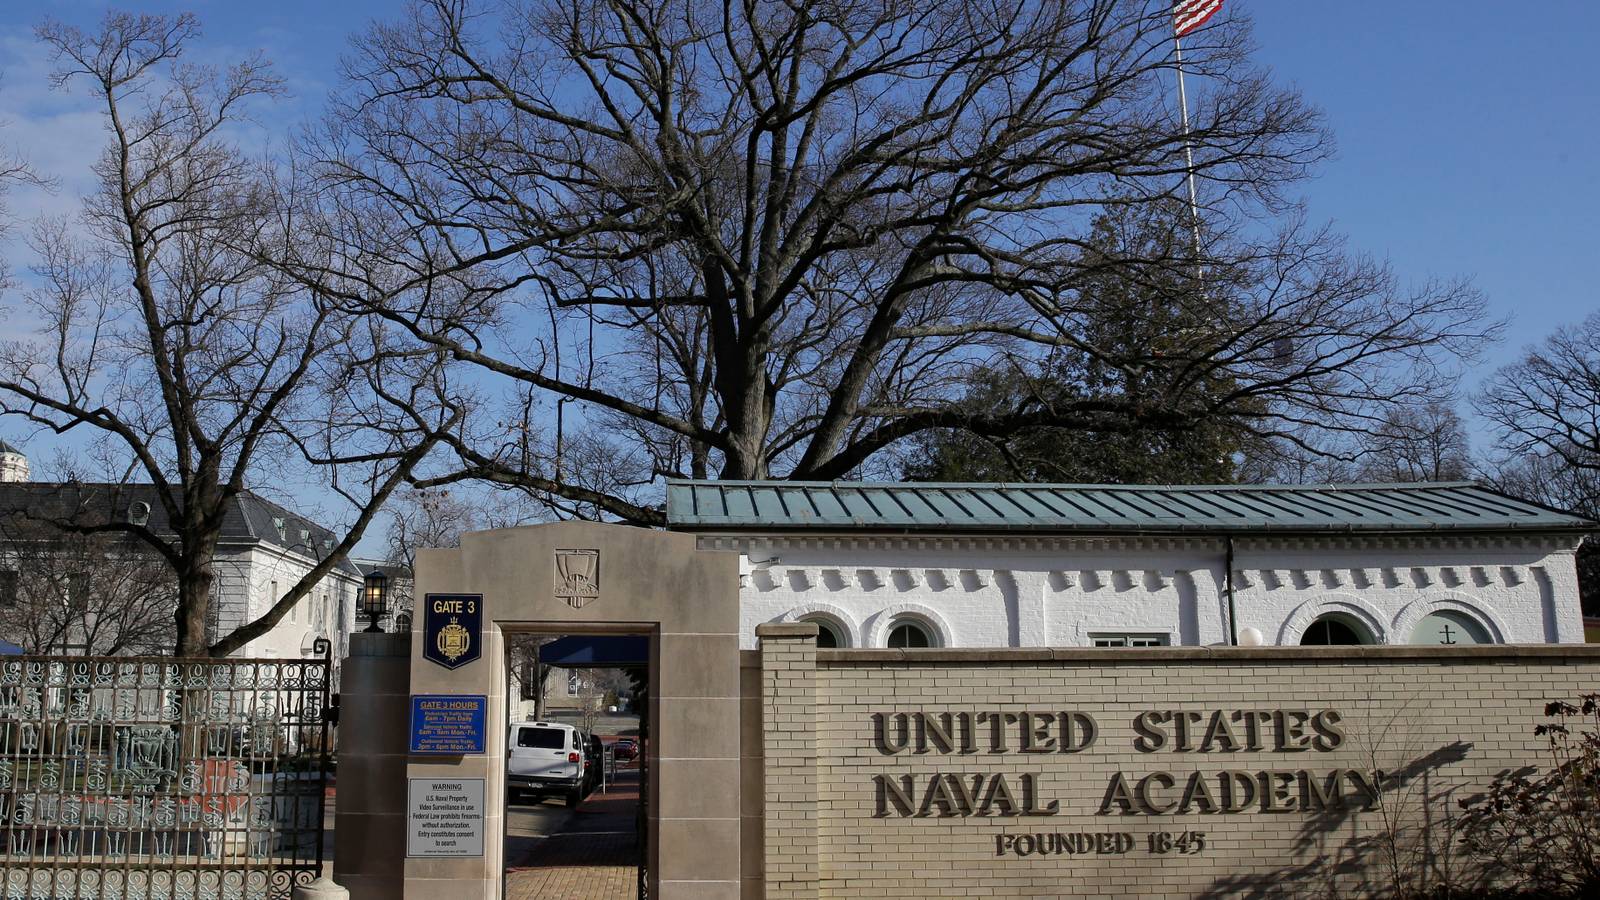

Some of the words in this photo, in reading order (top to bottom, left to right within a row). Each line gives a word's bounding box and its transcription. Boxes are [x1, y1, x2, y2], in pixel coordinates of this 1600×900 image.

[433, 600, 463, 613] GATE
[467, 600, 475, 614] 3
[420, 701, 442, 709] GATE
[443, 701, 448, 709] 3
[449, 701, 479, 709] HOURS
[870, 711, 1099, 755] UNITED
[1133, 708, 1346, 752] STATES
[431, 783, 462, 791] WARNING
[871, 772, 1060, 818] NAVAL
[1095, 768, 1385, 816] ACADEMY
[440, 813, 461, 821] prohibits
[995, 832, 1136, 857] FOUNDED
[1147, 830, 1206, 855] 1845
